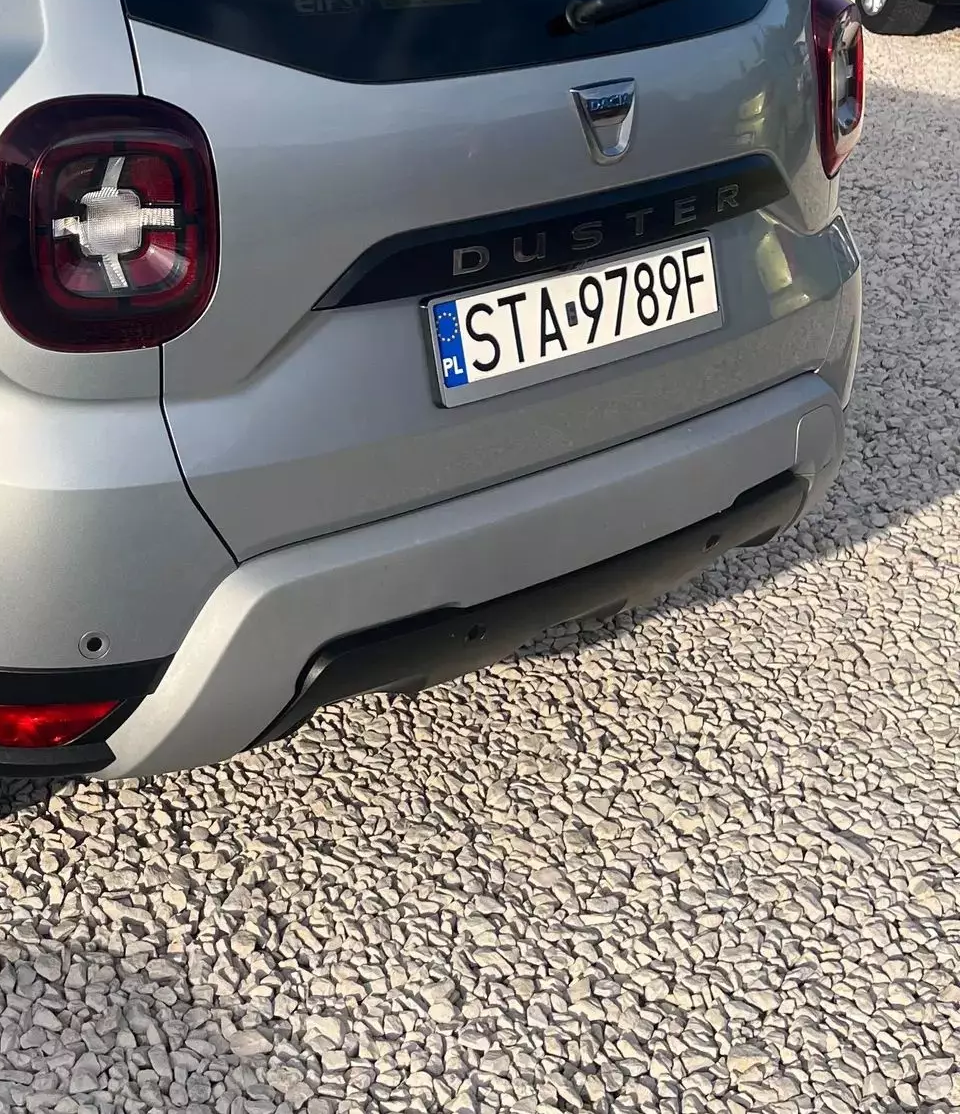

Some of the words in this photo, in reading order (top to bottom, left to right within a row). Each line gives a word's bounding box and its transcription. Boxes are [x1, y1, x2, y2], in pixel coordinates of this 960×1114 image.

[452, 183, 739, 276] DUSTER
[465, 286, 568, 372] STA
[578, 246, 705, 344] 9789F
[442, 355, 464, 377] PL
